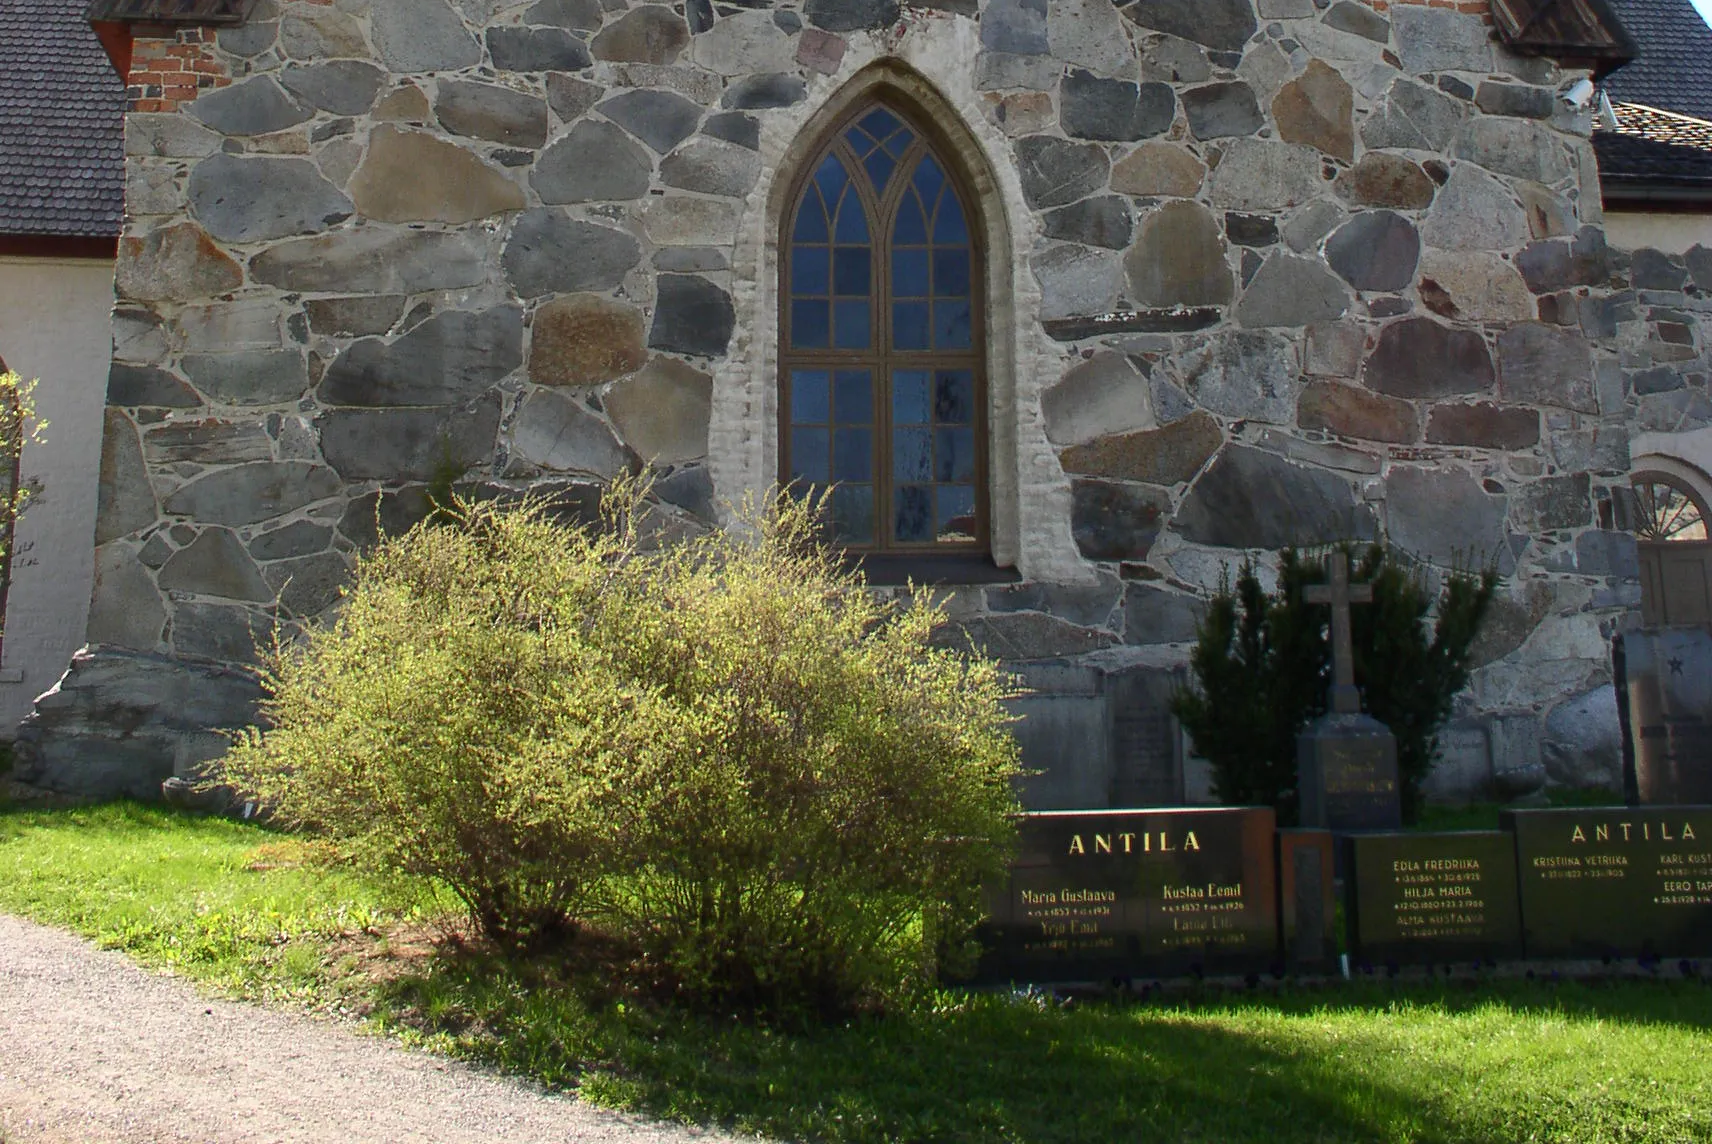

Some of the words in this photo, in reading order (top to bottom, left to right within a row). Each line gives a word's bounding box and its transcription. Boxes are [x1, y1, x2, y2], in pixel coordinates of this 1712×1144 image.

[1571, 821, 1696, 843] ANTILA
[1069, 831, 1201, 855] ANTILA
[1393, 860, 1420, 872] EDLA
[1425, 859, 1480, 871] FREDRIIKA
[1163, 884, 1204, 899] Kustaa
[1404, 887, 1435, 898] HILJA
[1439, 886, 1472, 897] MARIA
[1664, 881, 1692, 892] EERO
[1021, 889, 1056, 904] Maria
